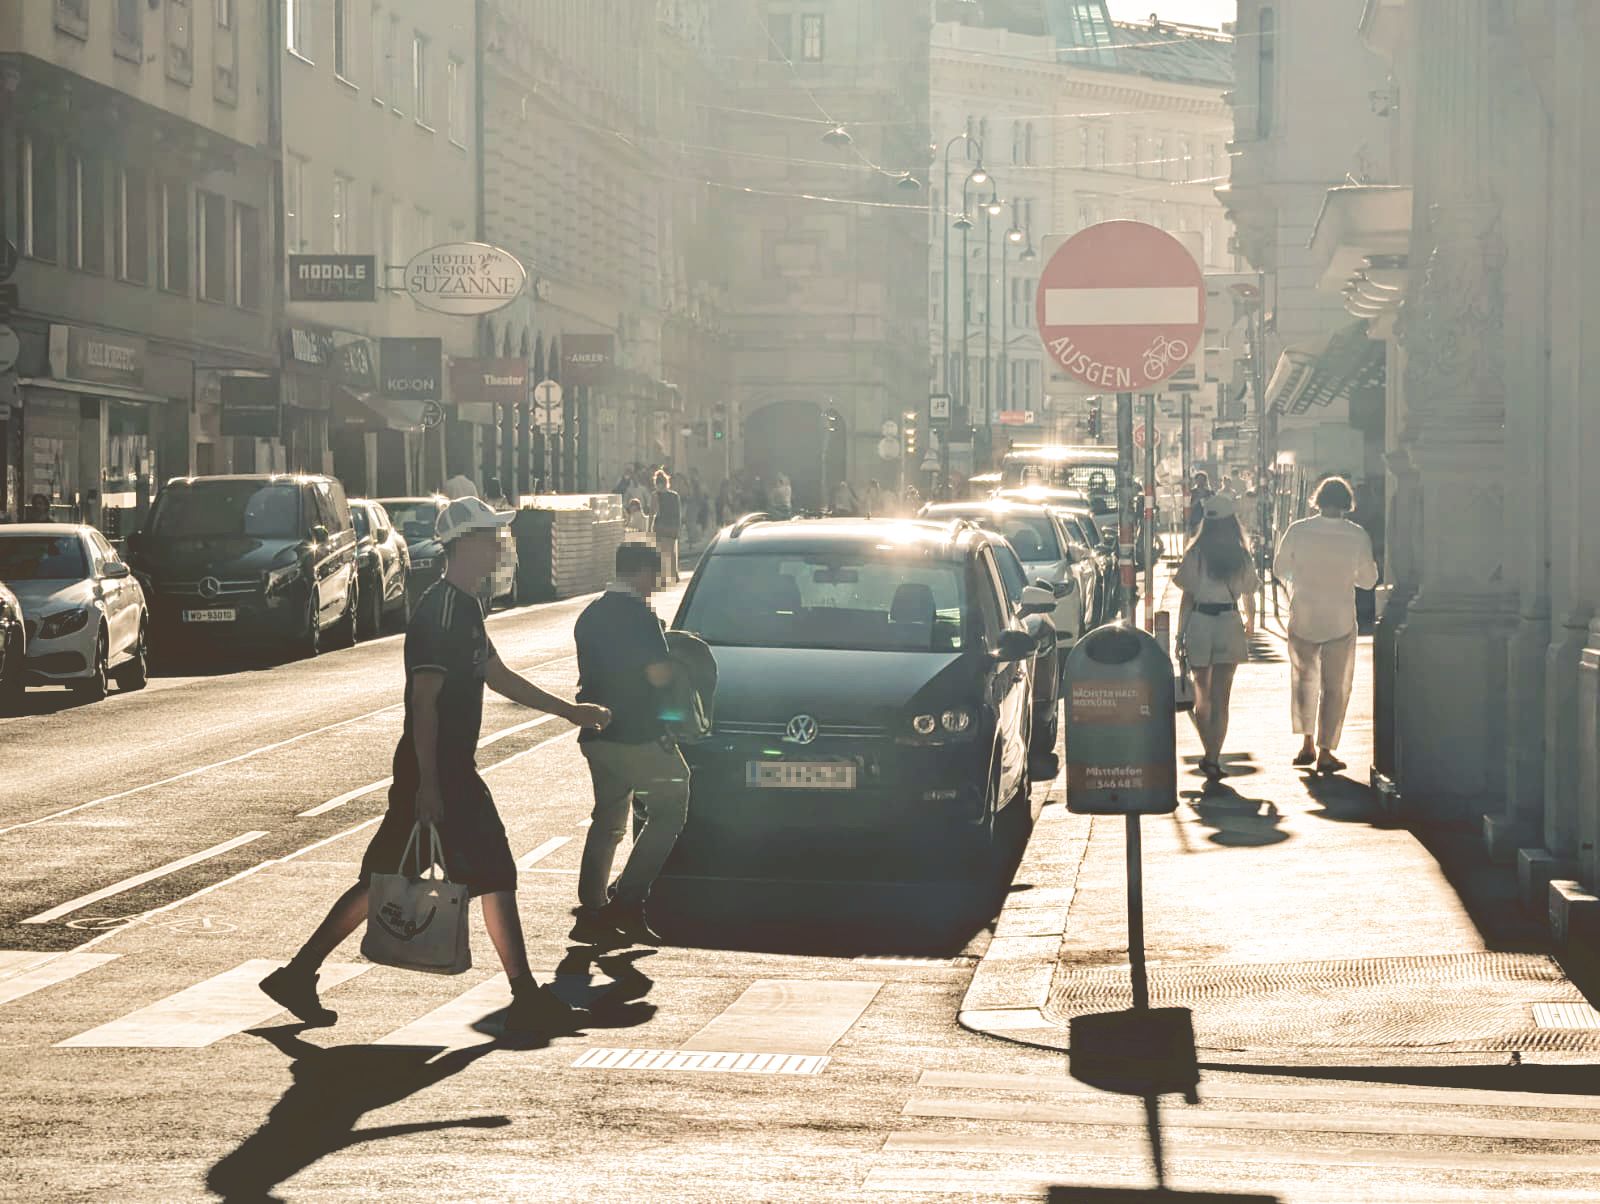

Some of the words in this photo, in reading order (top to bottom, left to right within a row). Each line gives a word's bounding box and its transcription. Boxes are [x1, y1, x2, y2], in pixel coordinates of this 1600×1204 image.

[432, 254, 476, 265] HOTEL
[299, 263, 366, 279] NOODLE
[416, 265, 476, 275] PENSION
[411, 276, 515, 294] SUZANNE
[1049, 336, 1137, 388] AUSGEN.
